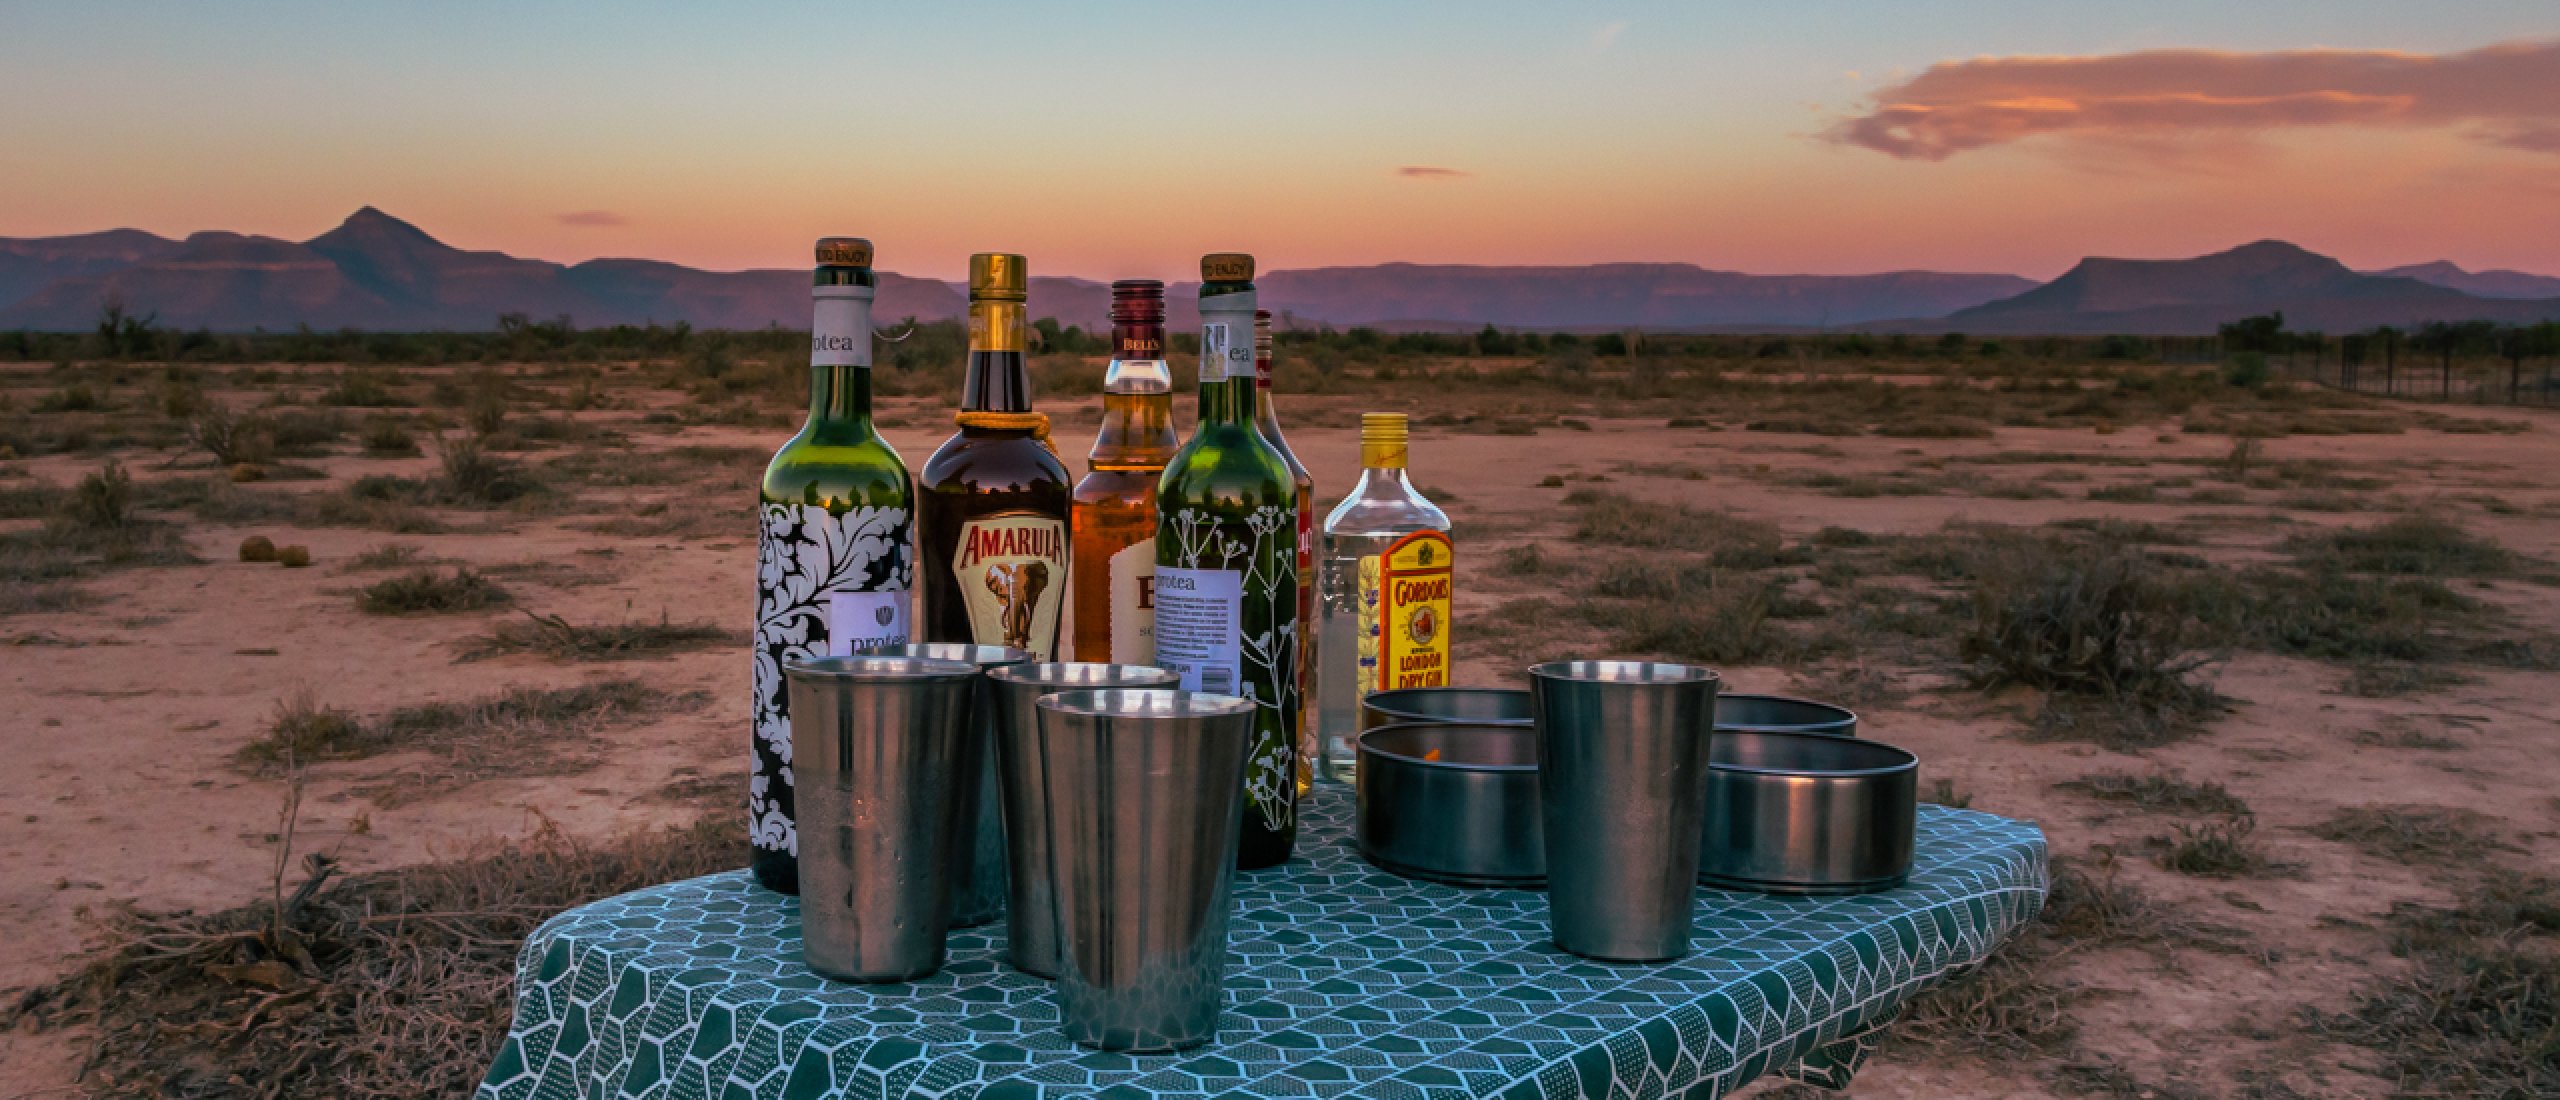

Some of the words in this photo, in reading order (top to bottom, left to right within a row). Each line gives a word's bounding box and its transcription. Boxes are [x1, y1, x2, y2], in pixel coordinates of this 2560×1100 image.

[1215, 263, 1246, 275] ENJOY
[813, 334, 853, 352] otea
[960, 525, 1063, 568] AMARULA
[1400, 653, 1441, 670] LONDON
[1399, 672, 1424, 689] DRY
[1426, 670, 1442, 688] GIN
